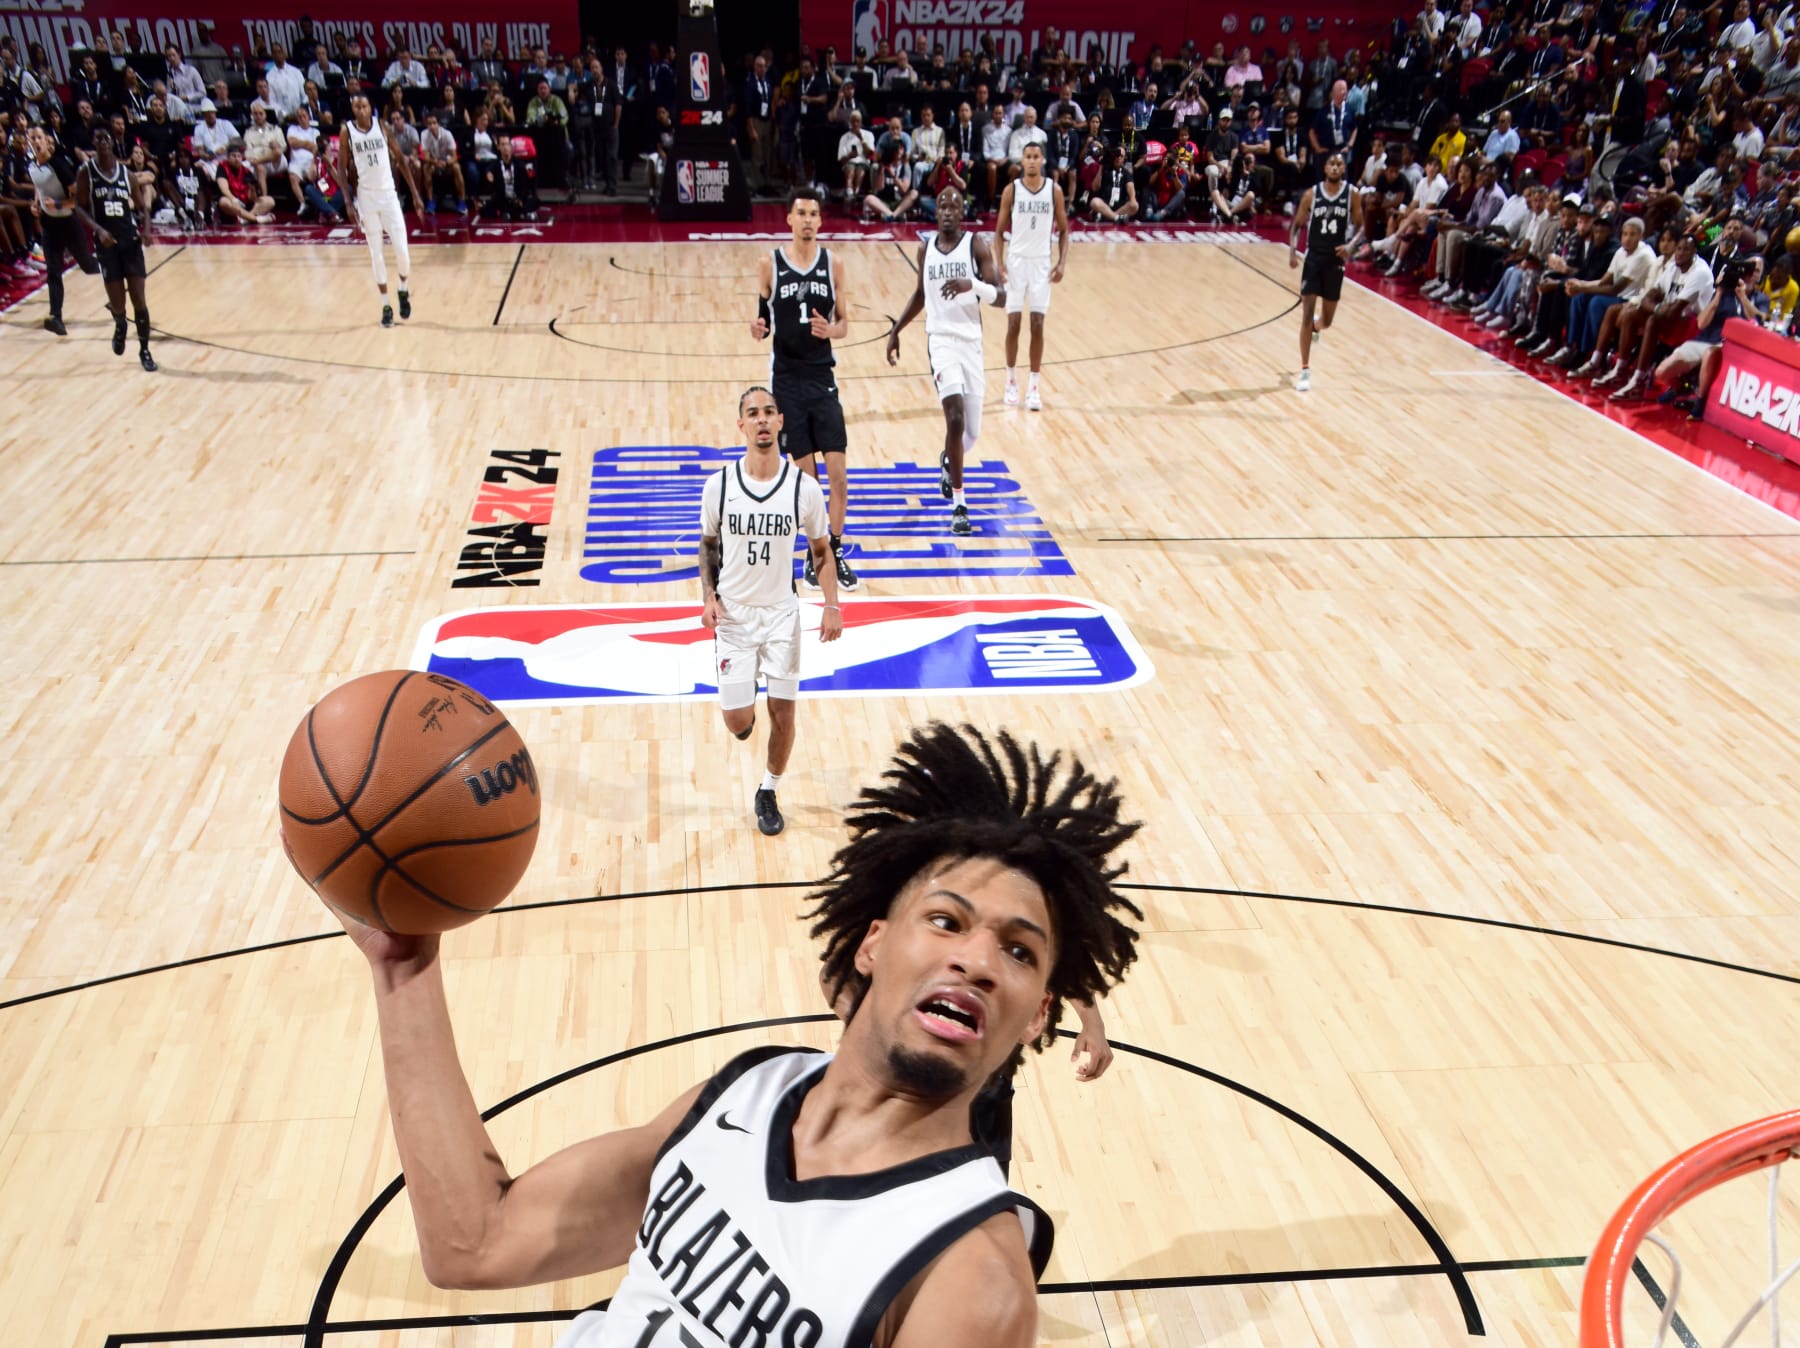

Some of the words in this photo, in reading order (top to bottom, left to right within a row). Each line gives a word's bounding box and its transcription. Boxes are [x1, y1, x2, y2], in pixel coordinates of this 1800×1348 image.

[680, 110, 723, 125] 2K24
[696, 169, 730, 185] SUMMER
[697, 185, 725, 202] LEAGUE
[1321, 219, 1338, 234] 14
[928, 262, 967, 281] BLAZERS
[799, 302, 809, 324] 1
[728, 513, 792, 537] BLAZERS
[747, 541, 771, 566] 54
[975, 628, 1103, 679] NBA
